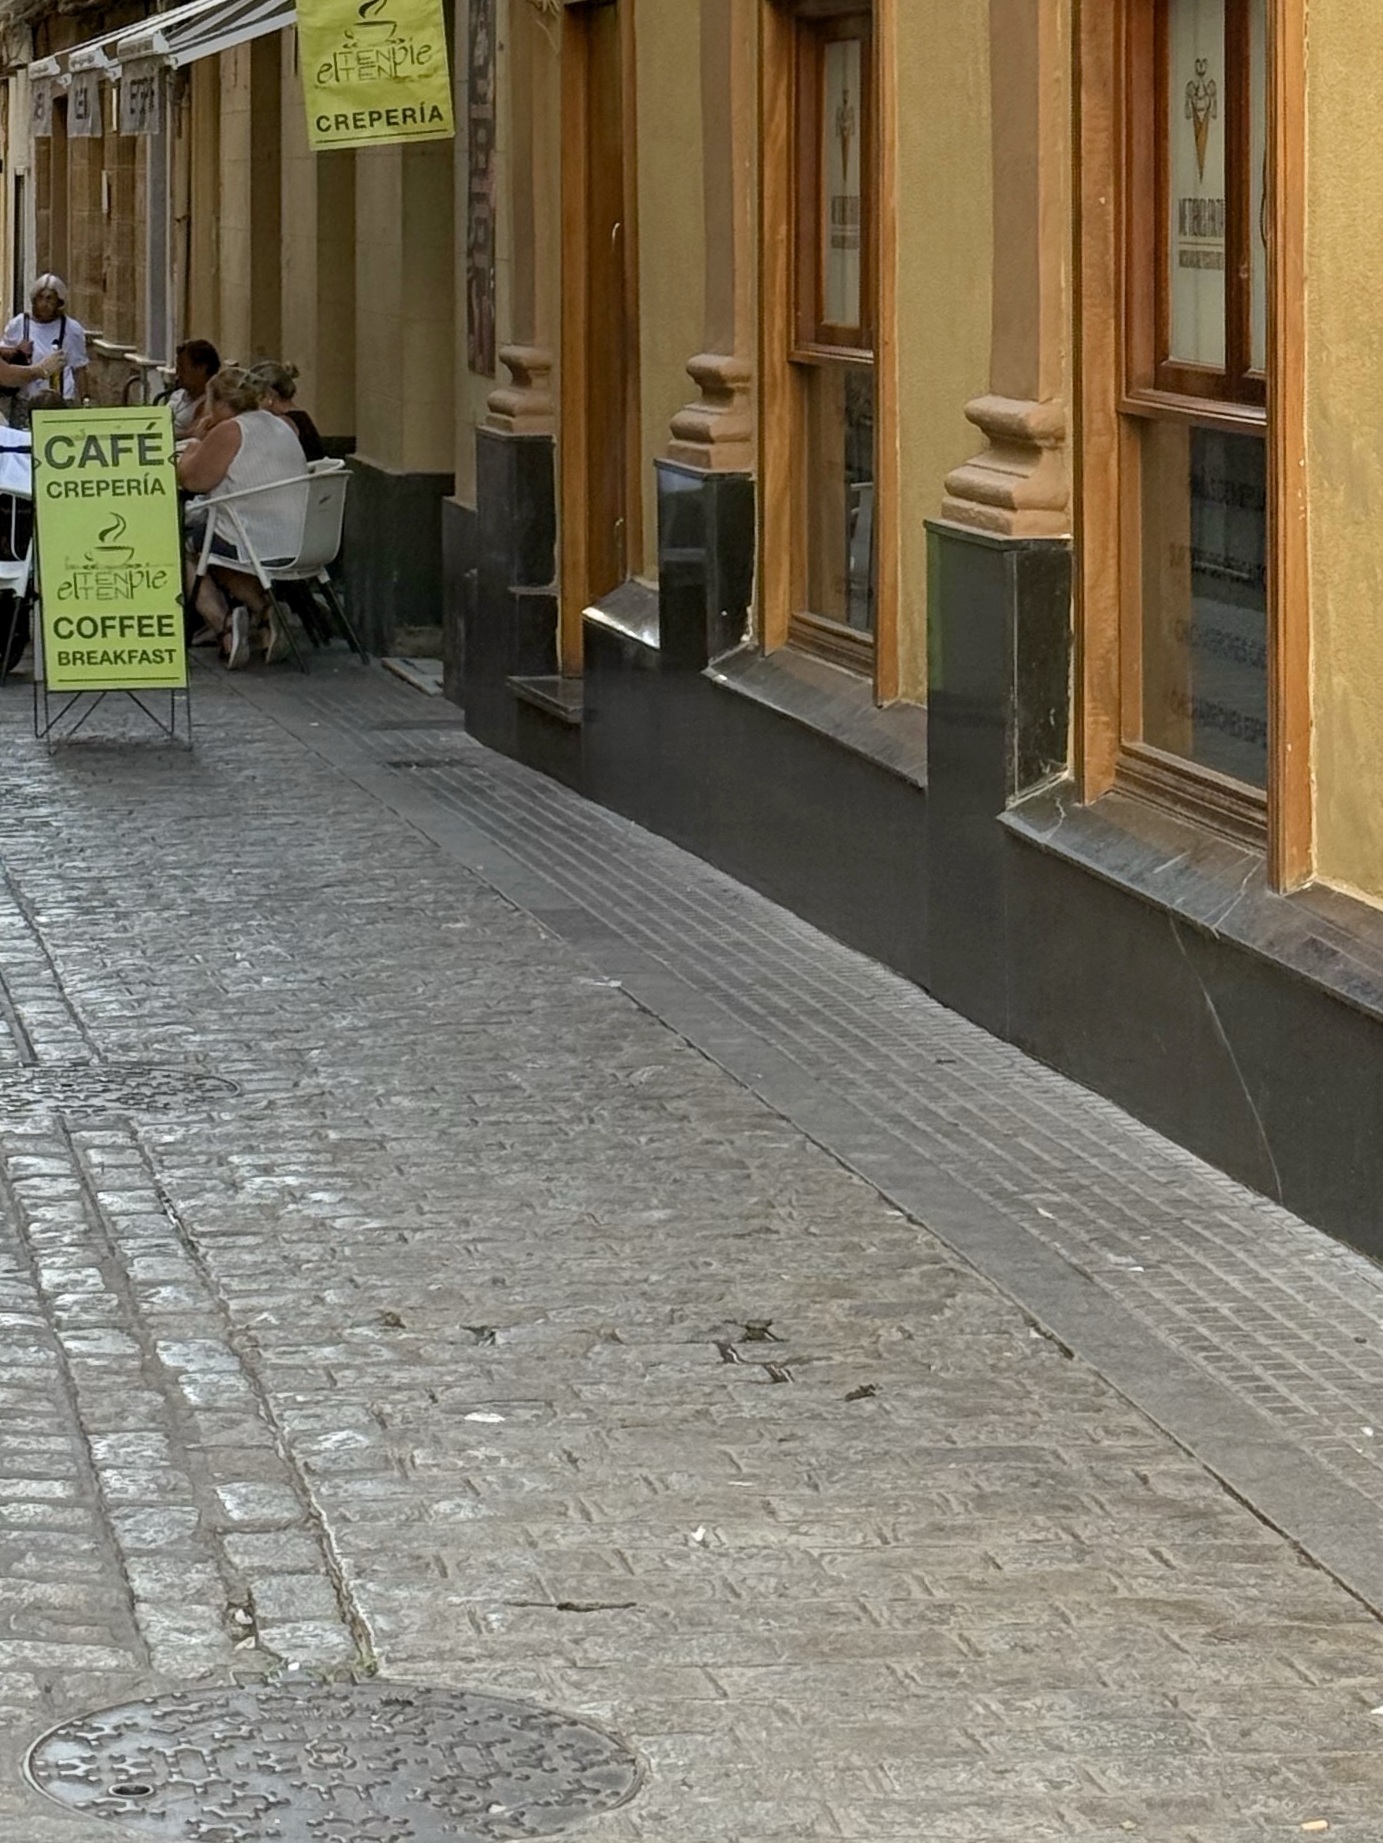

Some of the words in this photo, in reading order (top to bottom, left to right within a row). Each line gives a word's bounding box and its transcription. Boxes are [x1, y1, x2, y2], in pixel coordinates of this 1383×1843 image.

[316, 101, 444, 133] CREPERÍA
[44, 422, 164, 470] CAFÉ
[46, 473, 166, 499] CREPERÍA
[53, 615, 176, 640] COFFEE
[58, 649, 177, 667] BREAKFAST
